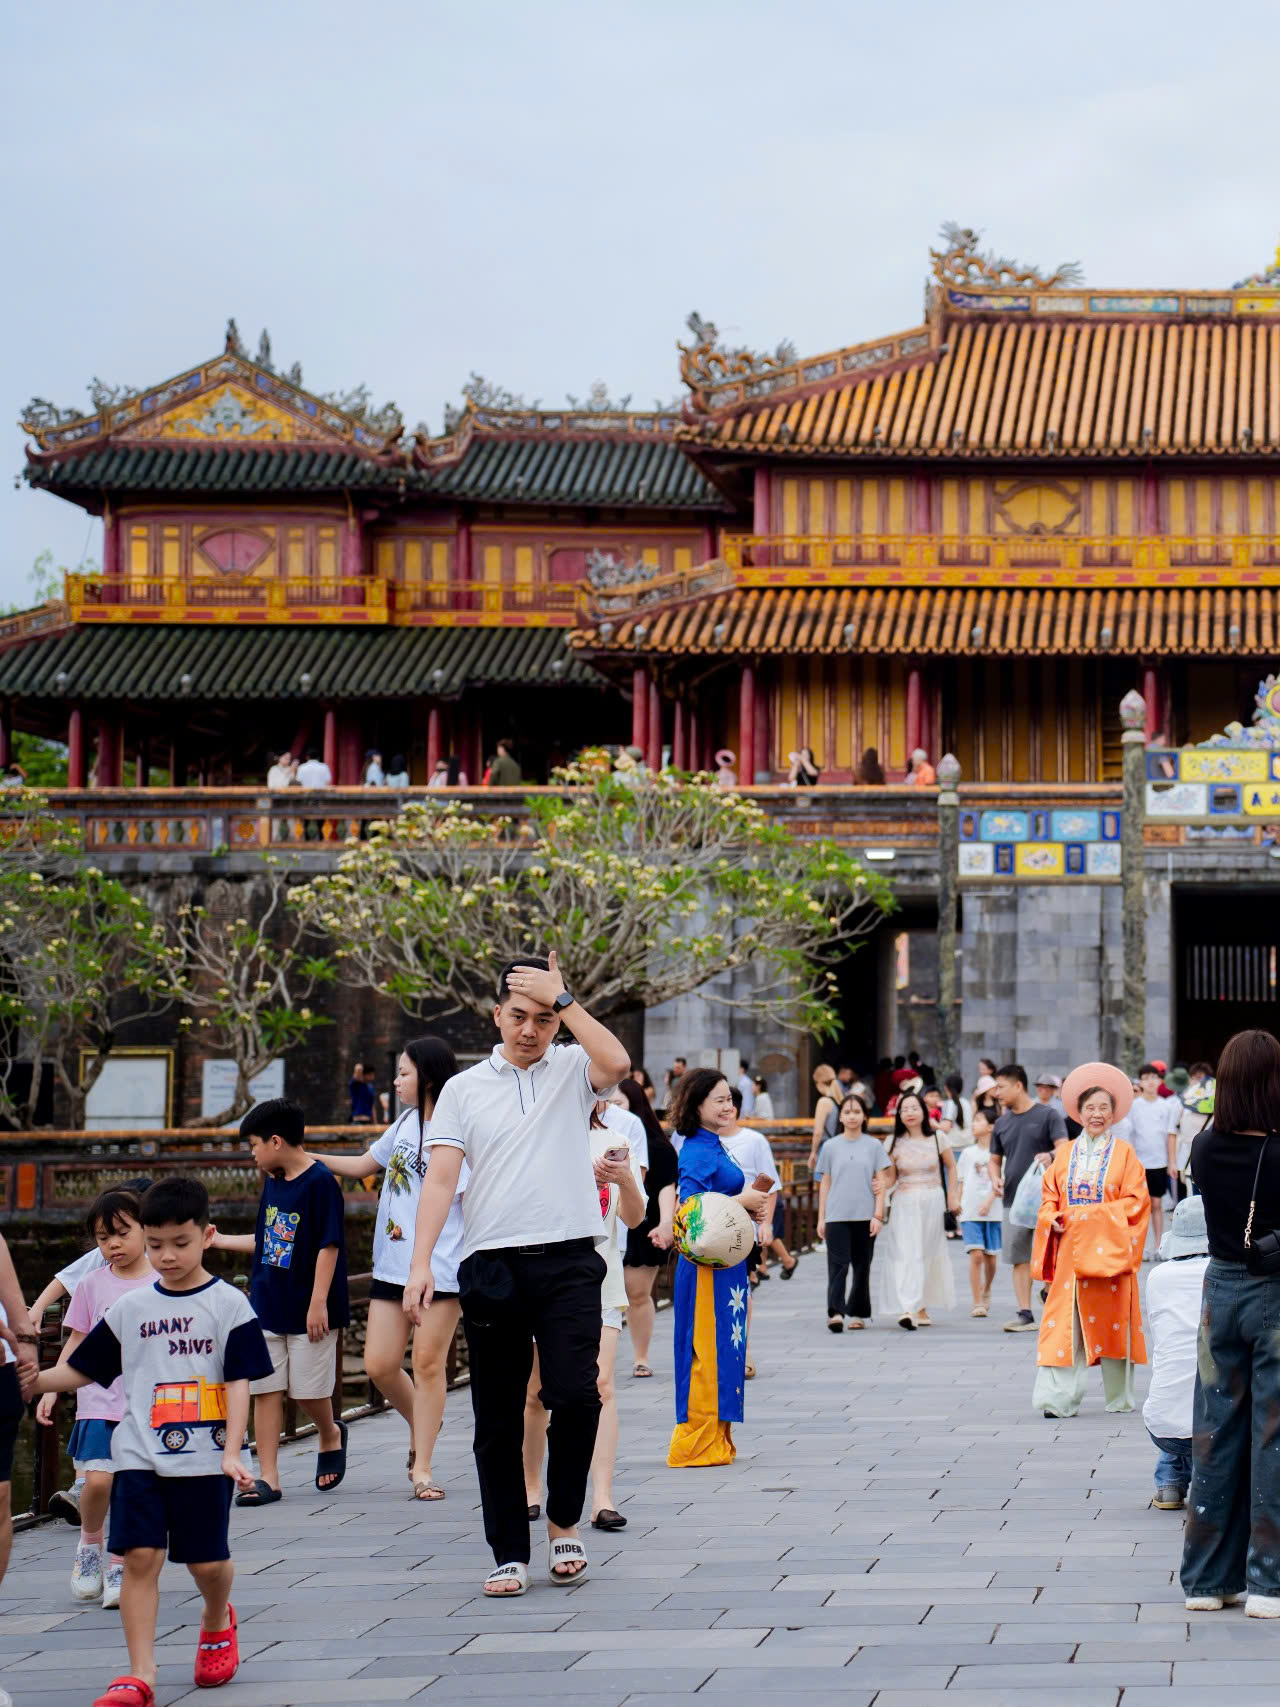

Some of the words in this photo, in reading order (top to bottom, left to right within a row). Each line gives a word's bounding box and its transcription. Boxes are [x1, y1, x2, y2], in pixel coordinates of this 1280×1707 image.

[139, 1316, 194, 1339] SUNNY
[168, 1338, 213, 1356] DRIVE
[554, 1543, 583, 1555] RIDER
